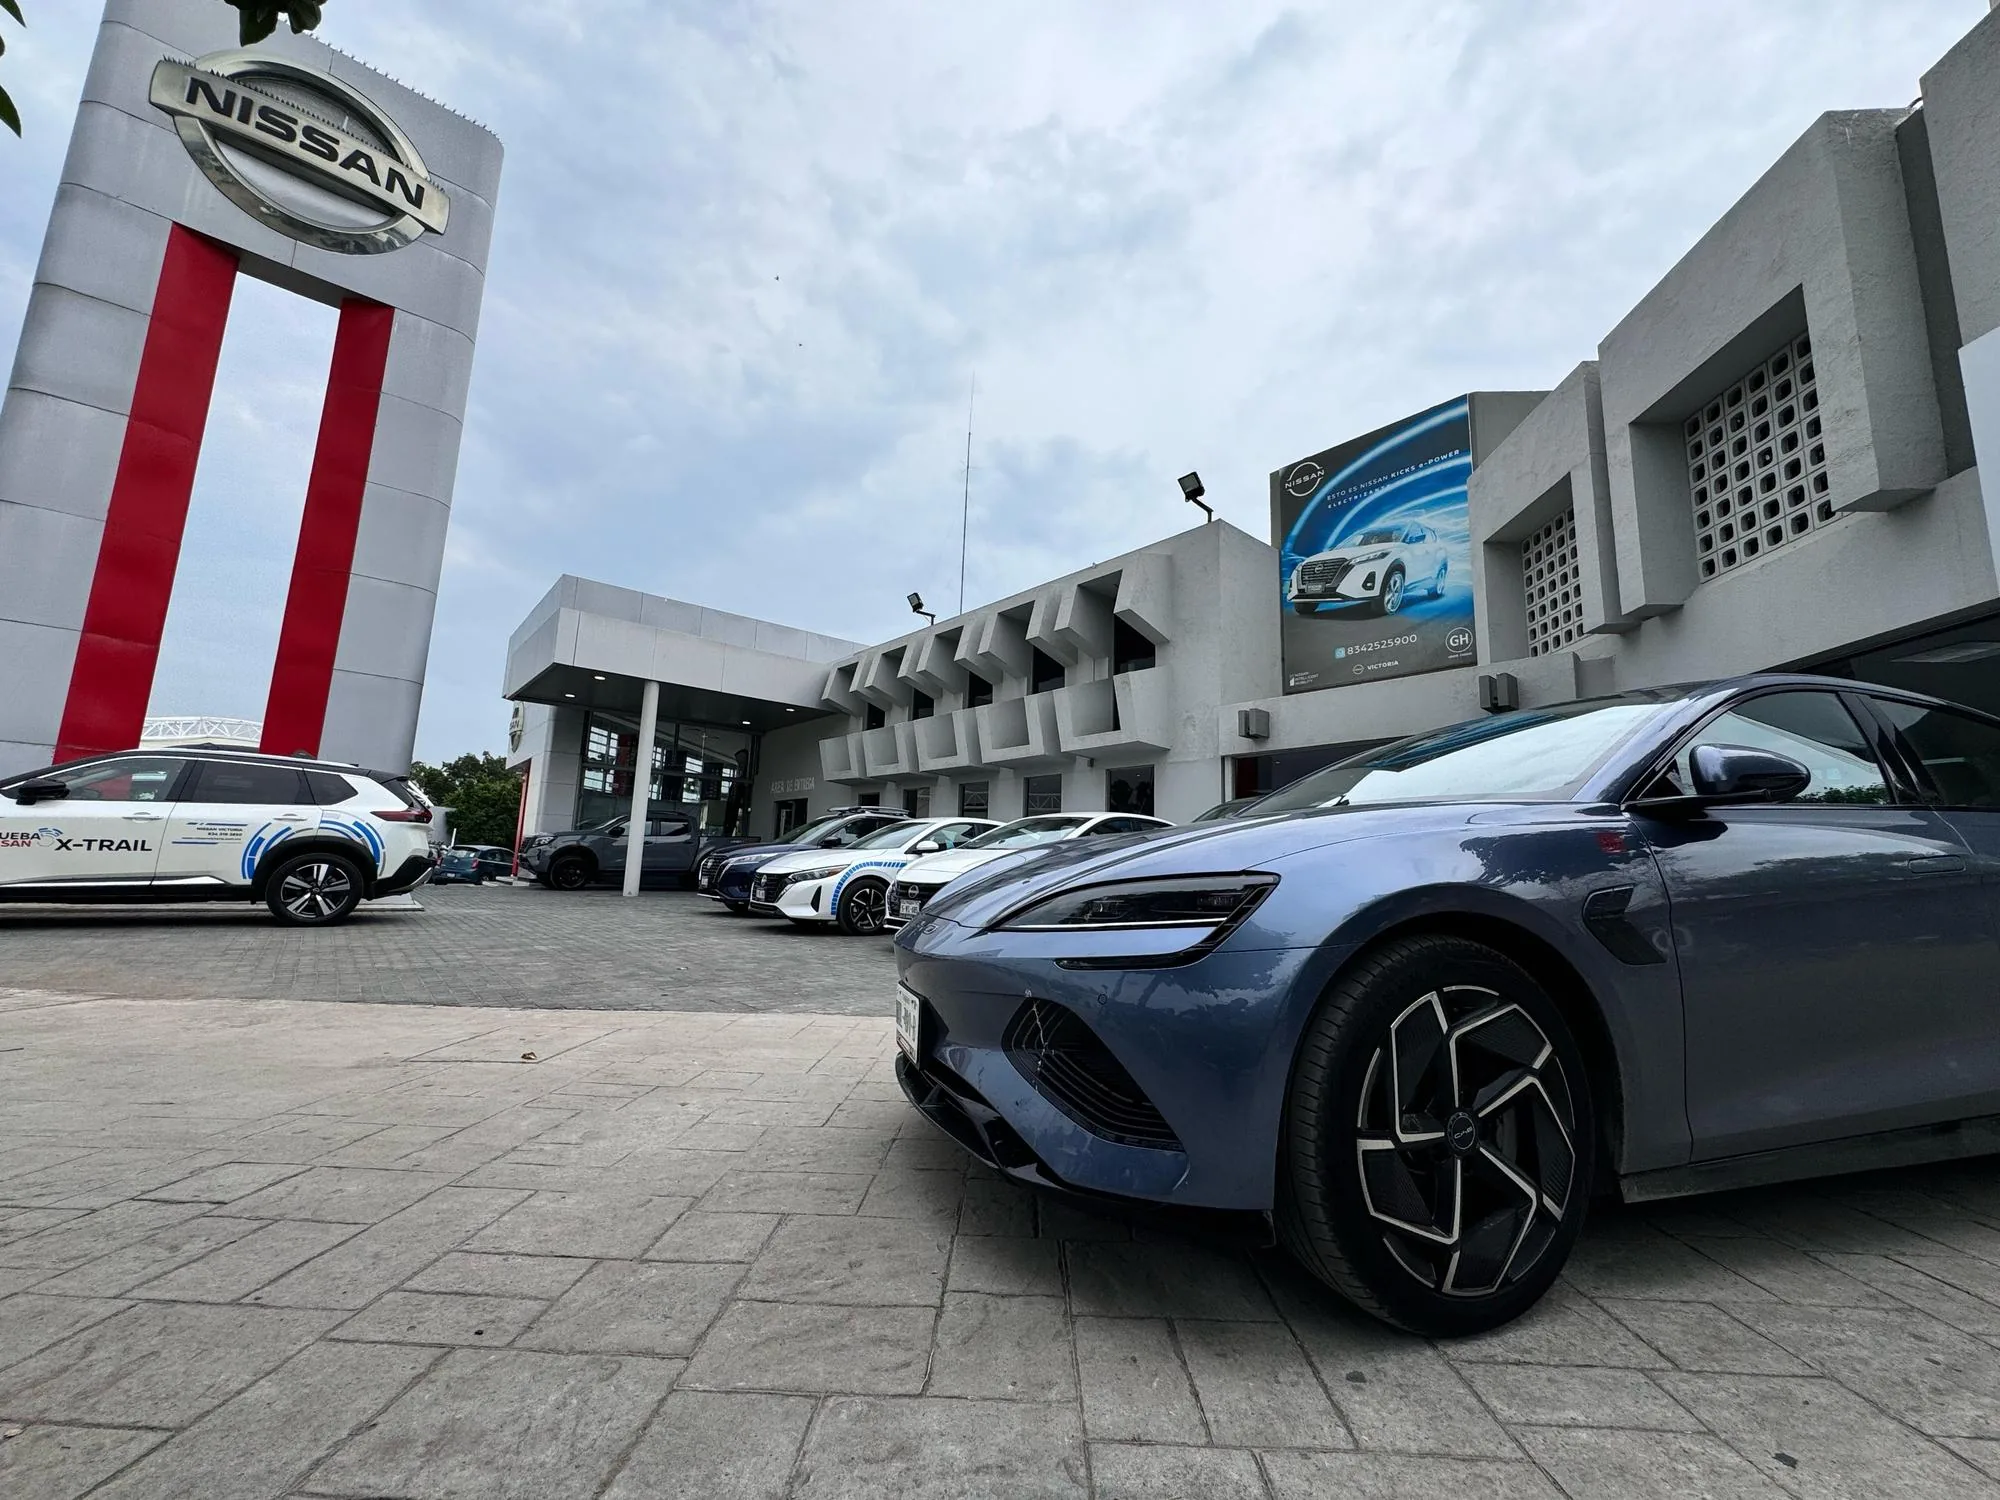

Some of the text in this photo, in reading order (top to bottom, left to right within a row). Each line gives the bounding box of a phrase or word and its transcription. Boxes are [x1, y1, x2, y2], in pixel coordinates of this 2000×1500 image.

[184, 76, 426, 210] NISSAN
[1284, 470, 1325, 489] NISSAN
[1327, 449, 1460, 501] ESTO ES NISSAN KICKS e-POWER
[1346, 634, 1418, 655] 8342525900
[1450, 633, 1469, 646] GH
[1367, 660, 1399, 670] VICTORIA
[55, 838, 153, 851] X-TRAIL
